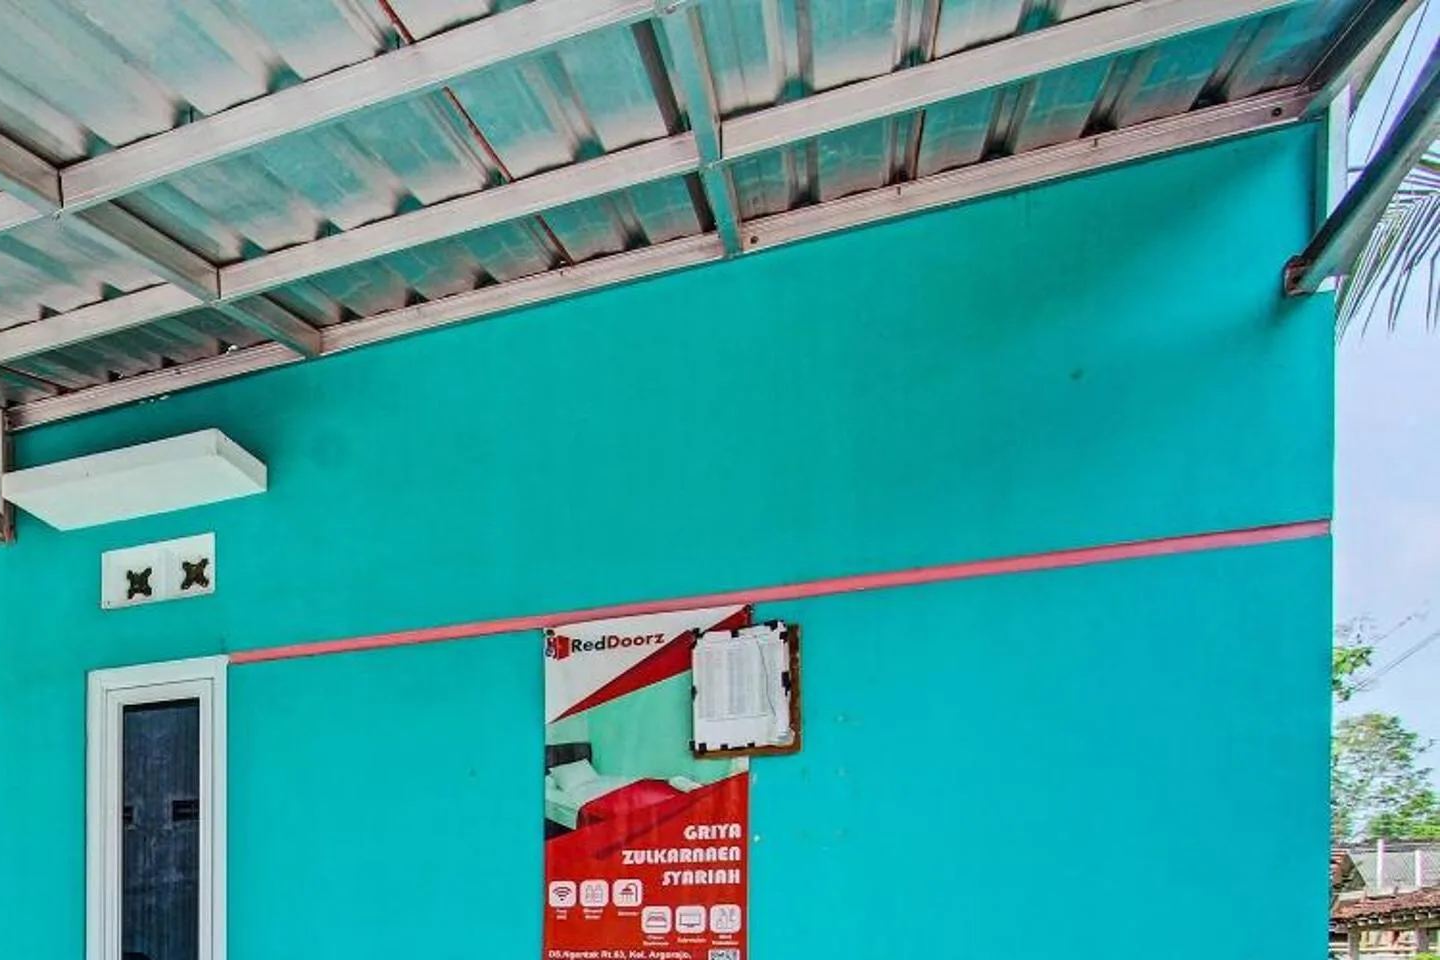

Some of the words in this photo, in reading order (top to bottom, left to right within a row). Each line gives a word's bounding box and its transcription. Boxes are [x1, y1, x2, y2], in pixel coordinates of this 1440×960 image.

[572, 633, 665, 653] RedDoorz
[683, 823, 742, 840] GRIYA
[621, 846, 742, 865] ZULKARNAEN
[662, 869, 741, 886] SYARIAH
